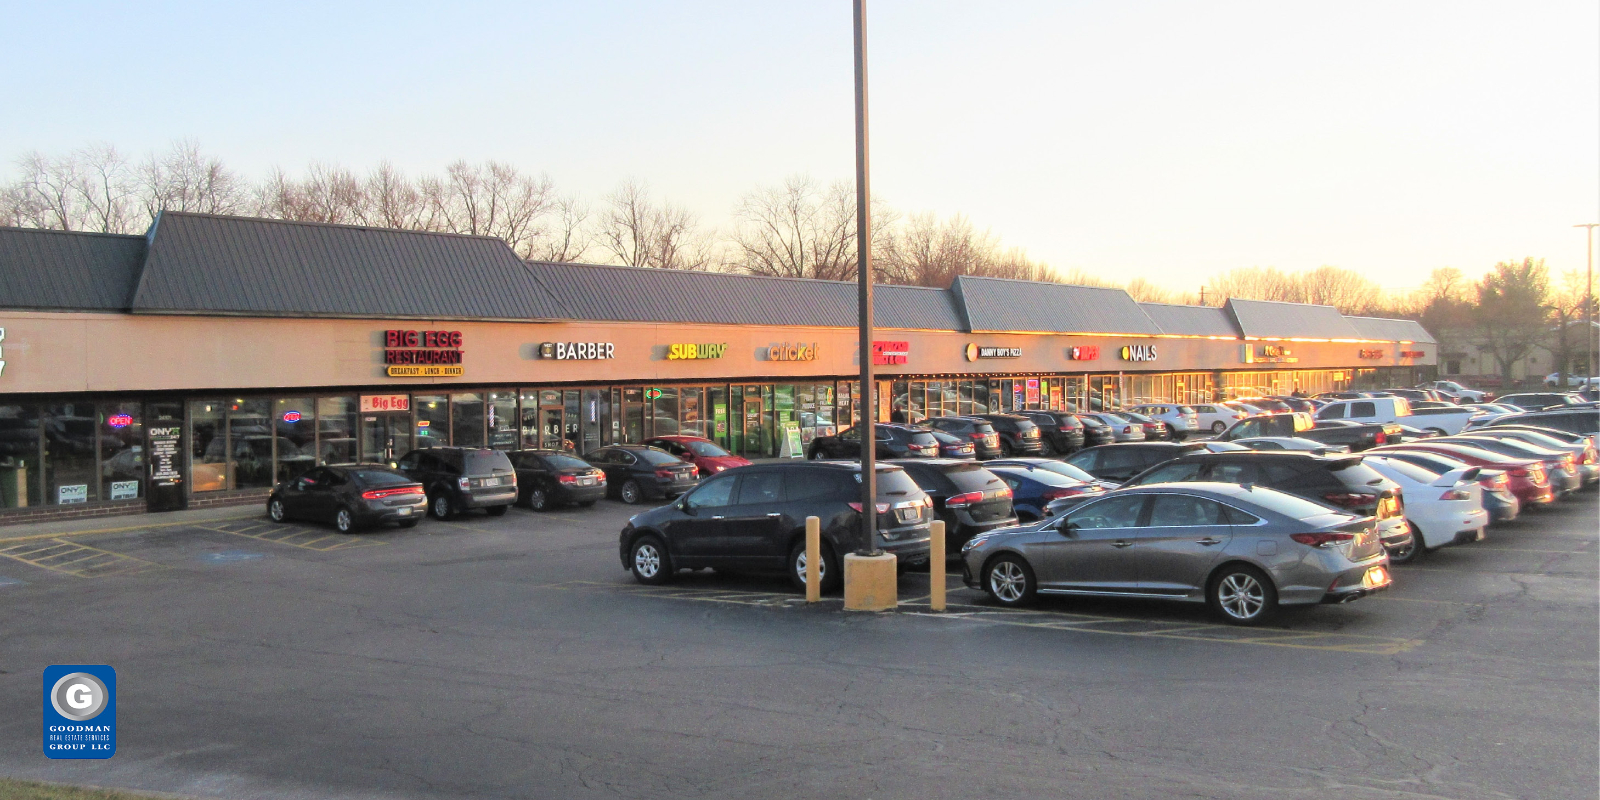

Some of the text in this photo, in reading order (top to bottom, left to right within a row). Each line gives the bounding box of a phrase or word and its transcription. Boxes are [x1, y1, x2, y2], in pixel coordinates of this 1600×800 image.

[386, 330, 463, 347] BIG EGG
[386, 350, 464, 364] RESTAURANT
[557, 342, 615, 360] BARBER
[668, 343, 726, 360] SUBWAY
[769, 342, 819, 361] cricket
[980, 347, 1022, 357] DANNY BOY'S PIZZA
[1129, 345, 1157, 361] NAILS
[390, 367, 461, 375] BREAKFAST LUNCH DINNER
[372, 396, 408, 410] Big Egg
[109, 416, 131, 426] OPEN
